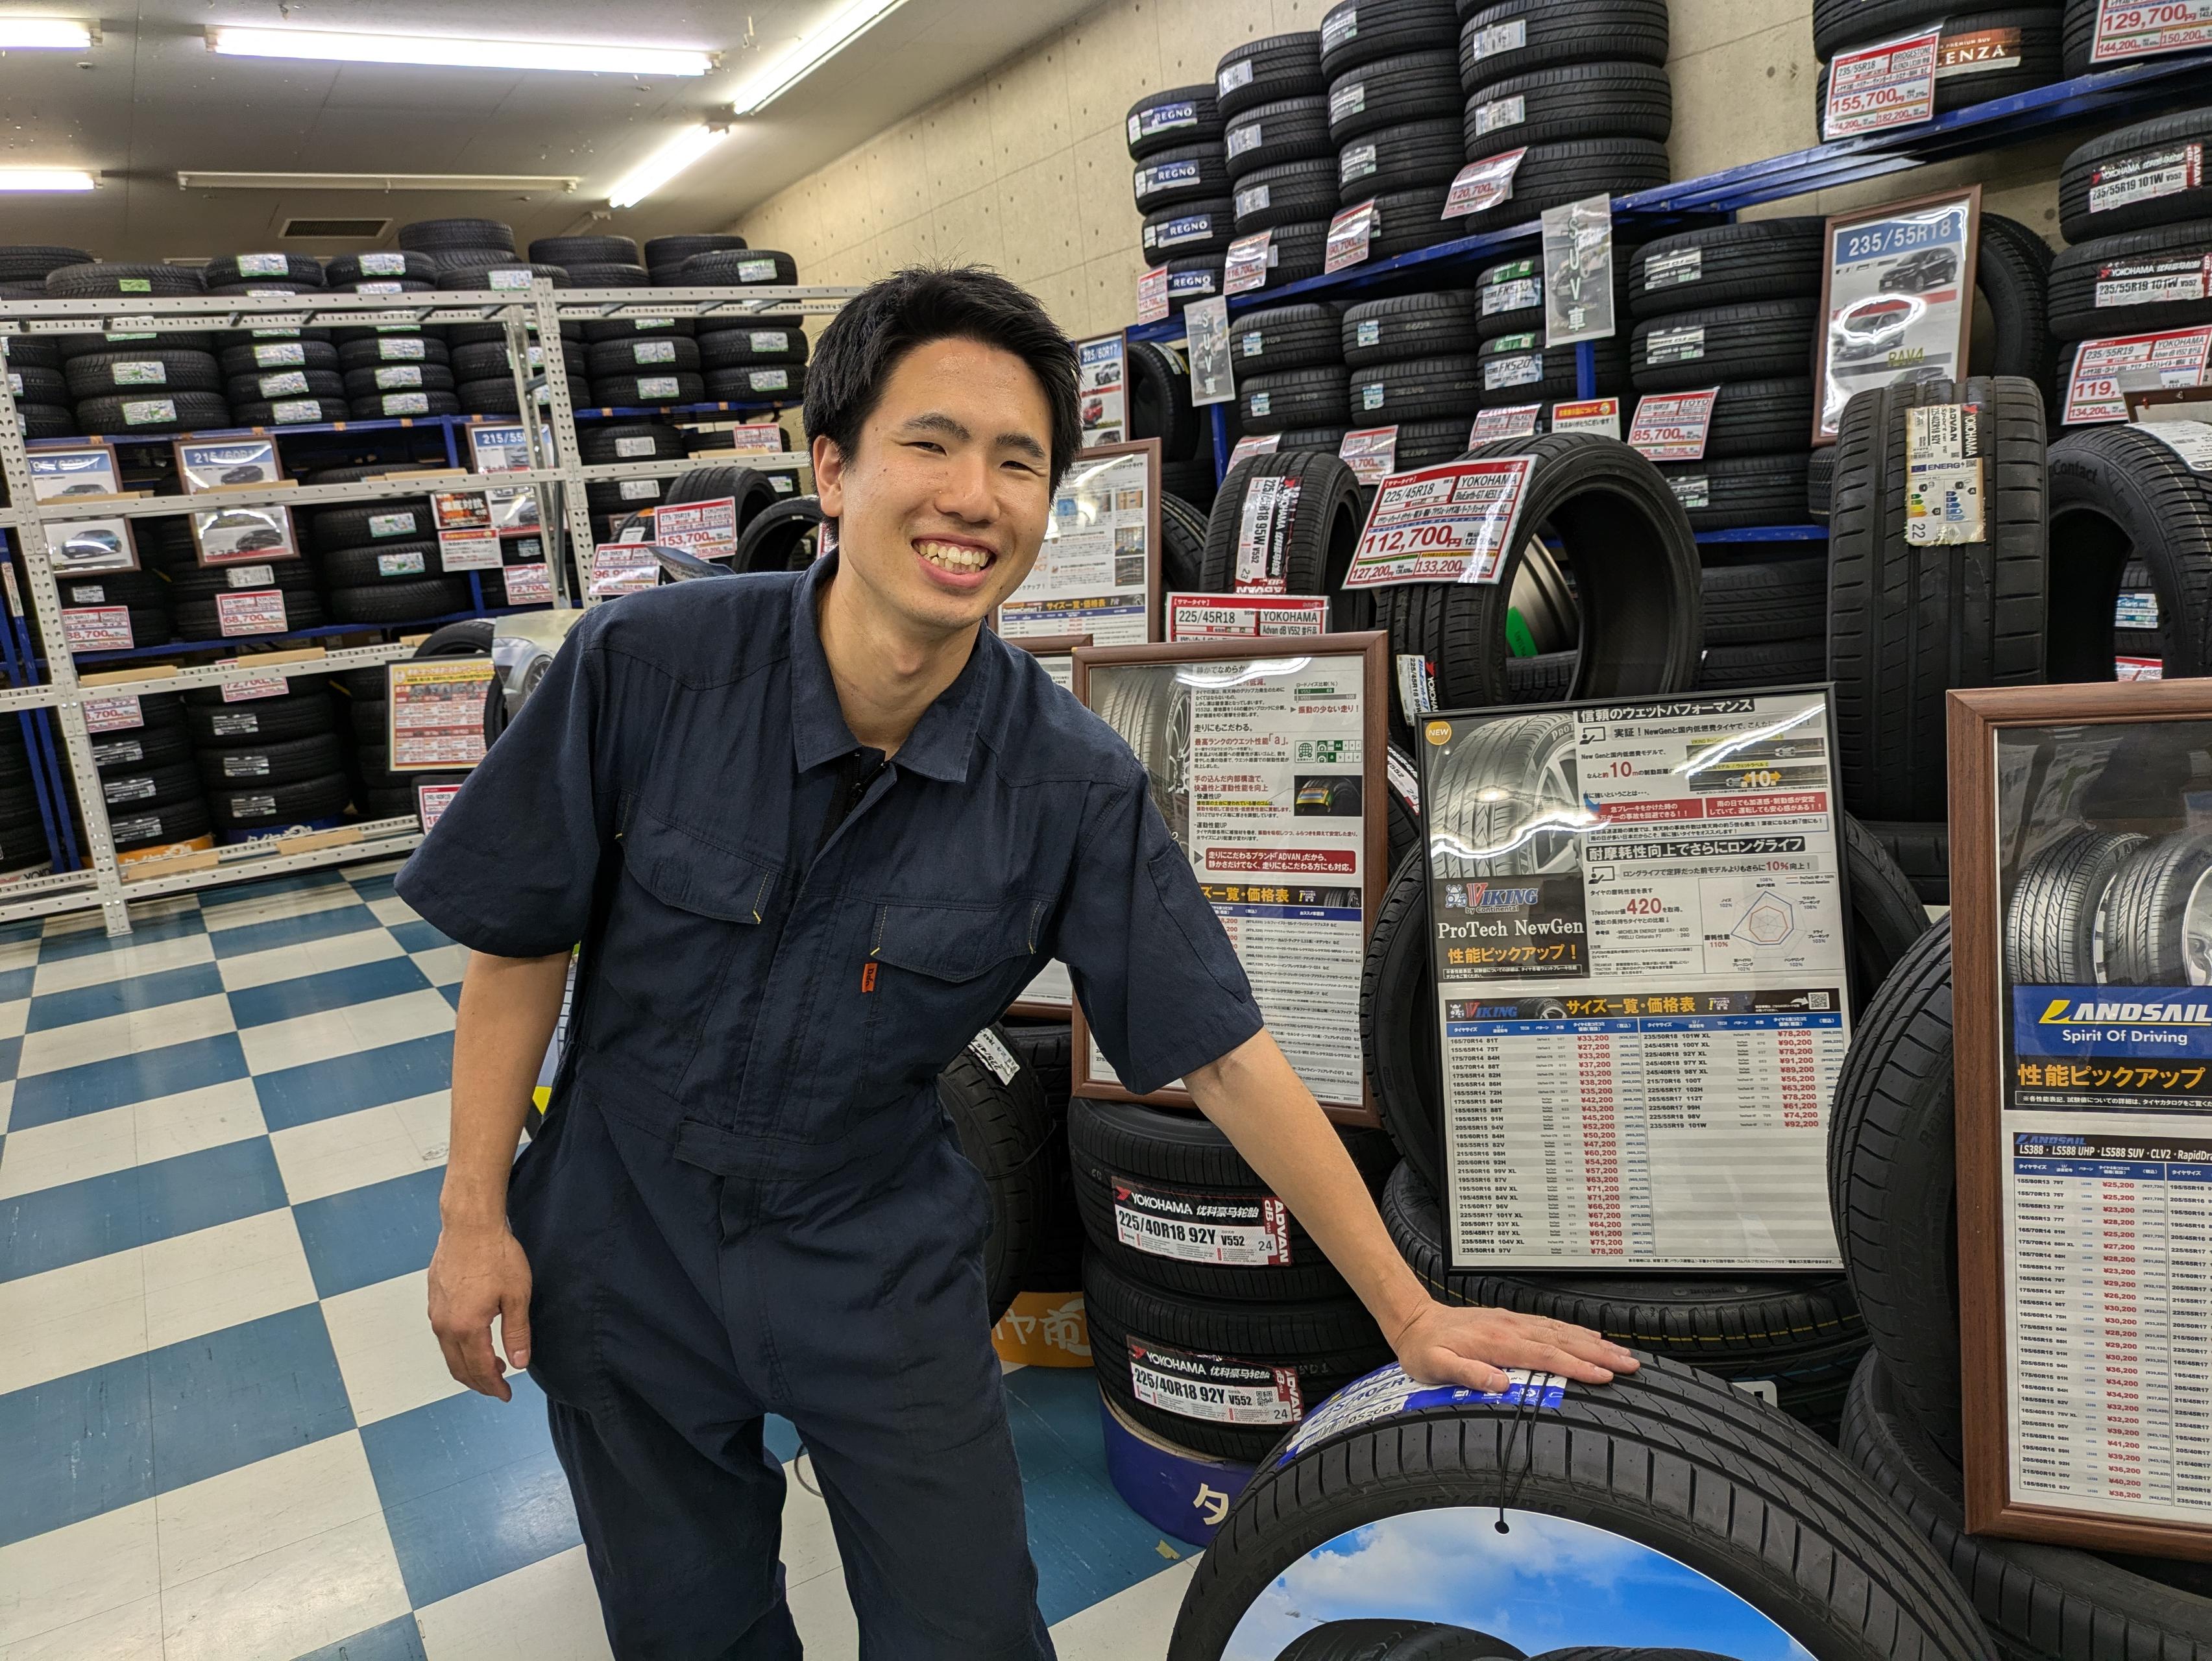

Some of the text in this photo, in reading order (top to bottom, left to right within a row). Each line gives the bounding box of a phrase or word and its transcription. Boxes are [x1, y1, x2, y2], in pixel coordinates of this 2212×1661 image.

[1937, 45, 2005, 66] ENZA
[1839, 61, 1875, 77] 235/55R18
[1154, 107, 1193, 122] REGNO
[1158, 166, 1196, 180] REGNO
[2102, 164, 2140, 180] YOKOHAMA
[2093, 173, 2182, 200] 235/55R19 101W V552
[1170, 221, 1208, 236] REGNO
[1849, 219, 1951, 256] 235/55R18
[2111, 265, 2154, 276] YOKOHAMA
[1174, 274, 1211, 287] REGNO
[2099, 280, 2148, 295] 235/55R19
[2152, 278, 2178, 289] 101W
[2086, 337, 2204, 359] 235/55R19 YOKOHAMA
[1888, 348, 1924, 367] RAV4
[2076, 381, 2116, 397] 119,
[1932, 435, 1941, 444] 92Y
[1965, 415, 1978, 457] YOKOHAMA
[1928, 462, 1960, 470] ENERG
[1384, 476, 1517, 503] 225/45R18 YOKOHAMA
[1254, 522, 1267, 545] 95W
[1912, 524, 1925, 539] 22
[1251, 547, 1259, 564] V552
[1241, 568, 1250, 579] 23
[1179, 610, 1317, 623] 225/45R18 YOKOHAMA
[1263, 625, 1278, 635] Advan
[1410, 658, 1419, 696] 225/45R18
[1298, 705, 1359, 714] 振動の少ない走り！
[1581, 699, 1752, 722] 信頼のウェットパフォーマンス
[1610, 804, 1677, 813] 急ブレーキをかけた時の
[1717, 795, 1815, 806] 雨の日でも加速感・制動感が安定
[1209, 851, 1327, 862] 走りにこだわるブランド「ADVAN」だから、
[1589, 838, 1803, 861] 耐摩耗性向上でさらにロングライフ
[1209, 860, 1352, 871] 静かさだけでなく、走りにもこだわる方にも対応。
[1466, 882, 1538, 907] VIKING
[1438, 918, 1585, 938] ProTech NewGen
[1448, 944, 1576, 964] 性能ピックアップ！
[1464, 1001, 1518, 1019] VIKING
[1567, 996, 1695, 1015] サイズ一覧・価格表
[2039, 1000, 2212, 1024] LANDSAIL
[2063, 1030, 2187, 1045] Spirit Of Driving
[2018, 1064, 2206, 1089] 性能ピックアップ
[2016, 1135, 2086, 1145] LANDSAIL
[2020, 1145, 2171, 1159] LS388 LS588 UHP LS588 SUV CLV2
[1131, 1193, 1193, 1215] YOKOHAMA
[1265, 1200, 1274, 1221] dB
[1119, 1209, 1245, 1246] 225/40R18 92Y V552
[1274, 1200, 1289, 1263] ADVAN
[1258, 1241, 1272, 1251] 24
[1147, 1351, 1206, 1375] YOKOHAMA
[1135, 1368, 1252, 1405] 225/40R18 92Y V552
[1284, 1370, 1302, 1421] ADVAN
[1274, 1409, 1288, 1420] 24
[1349, 1403, 1401, 1424] 052067
[2108, 1453, 2140, 1462] ¥39,200
